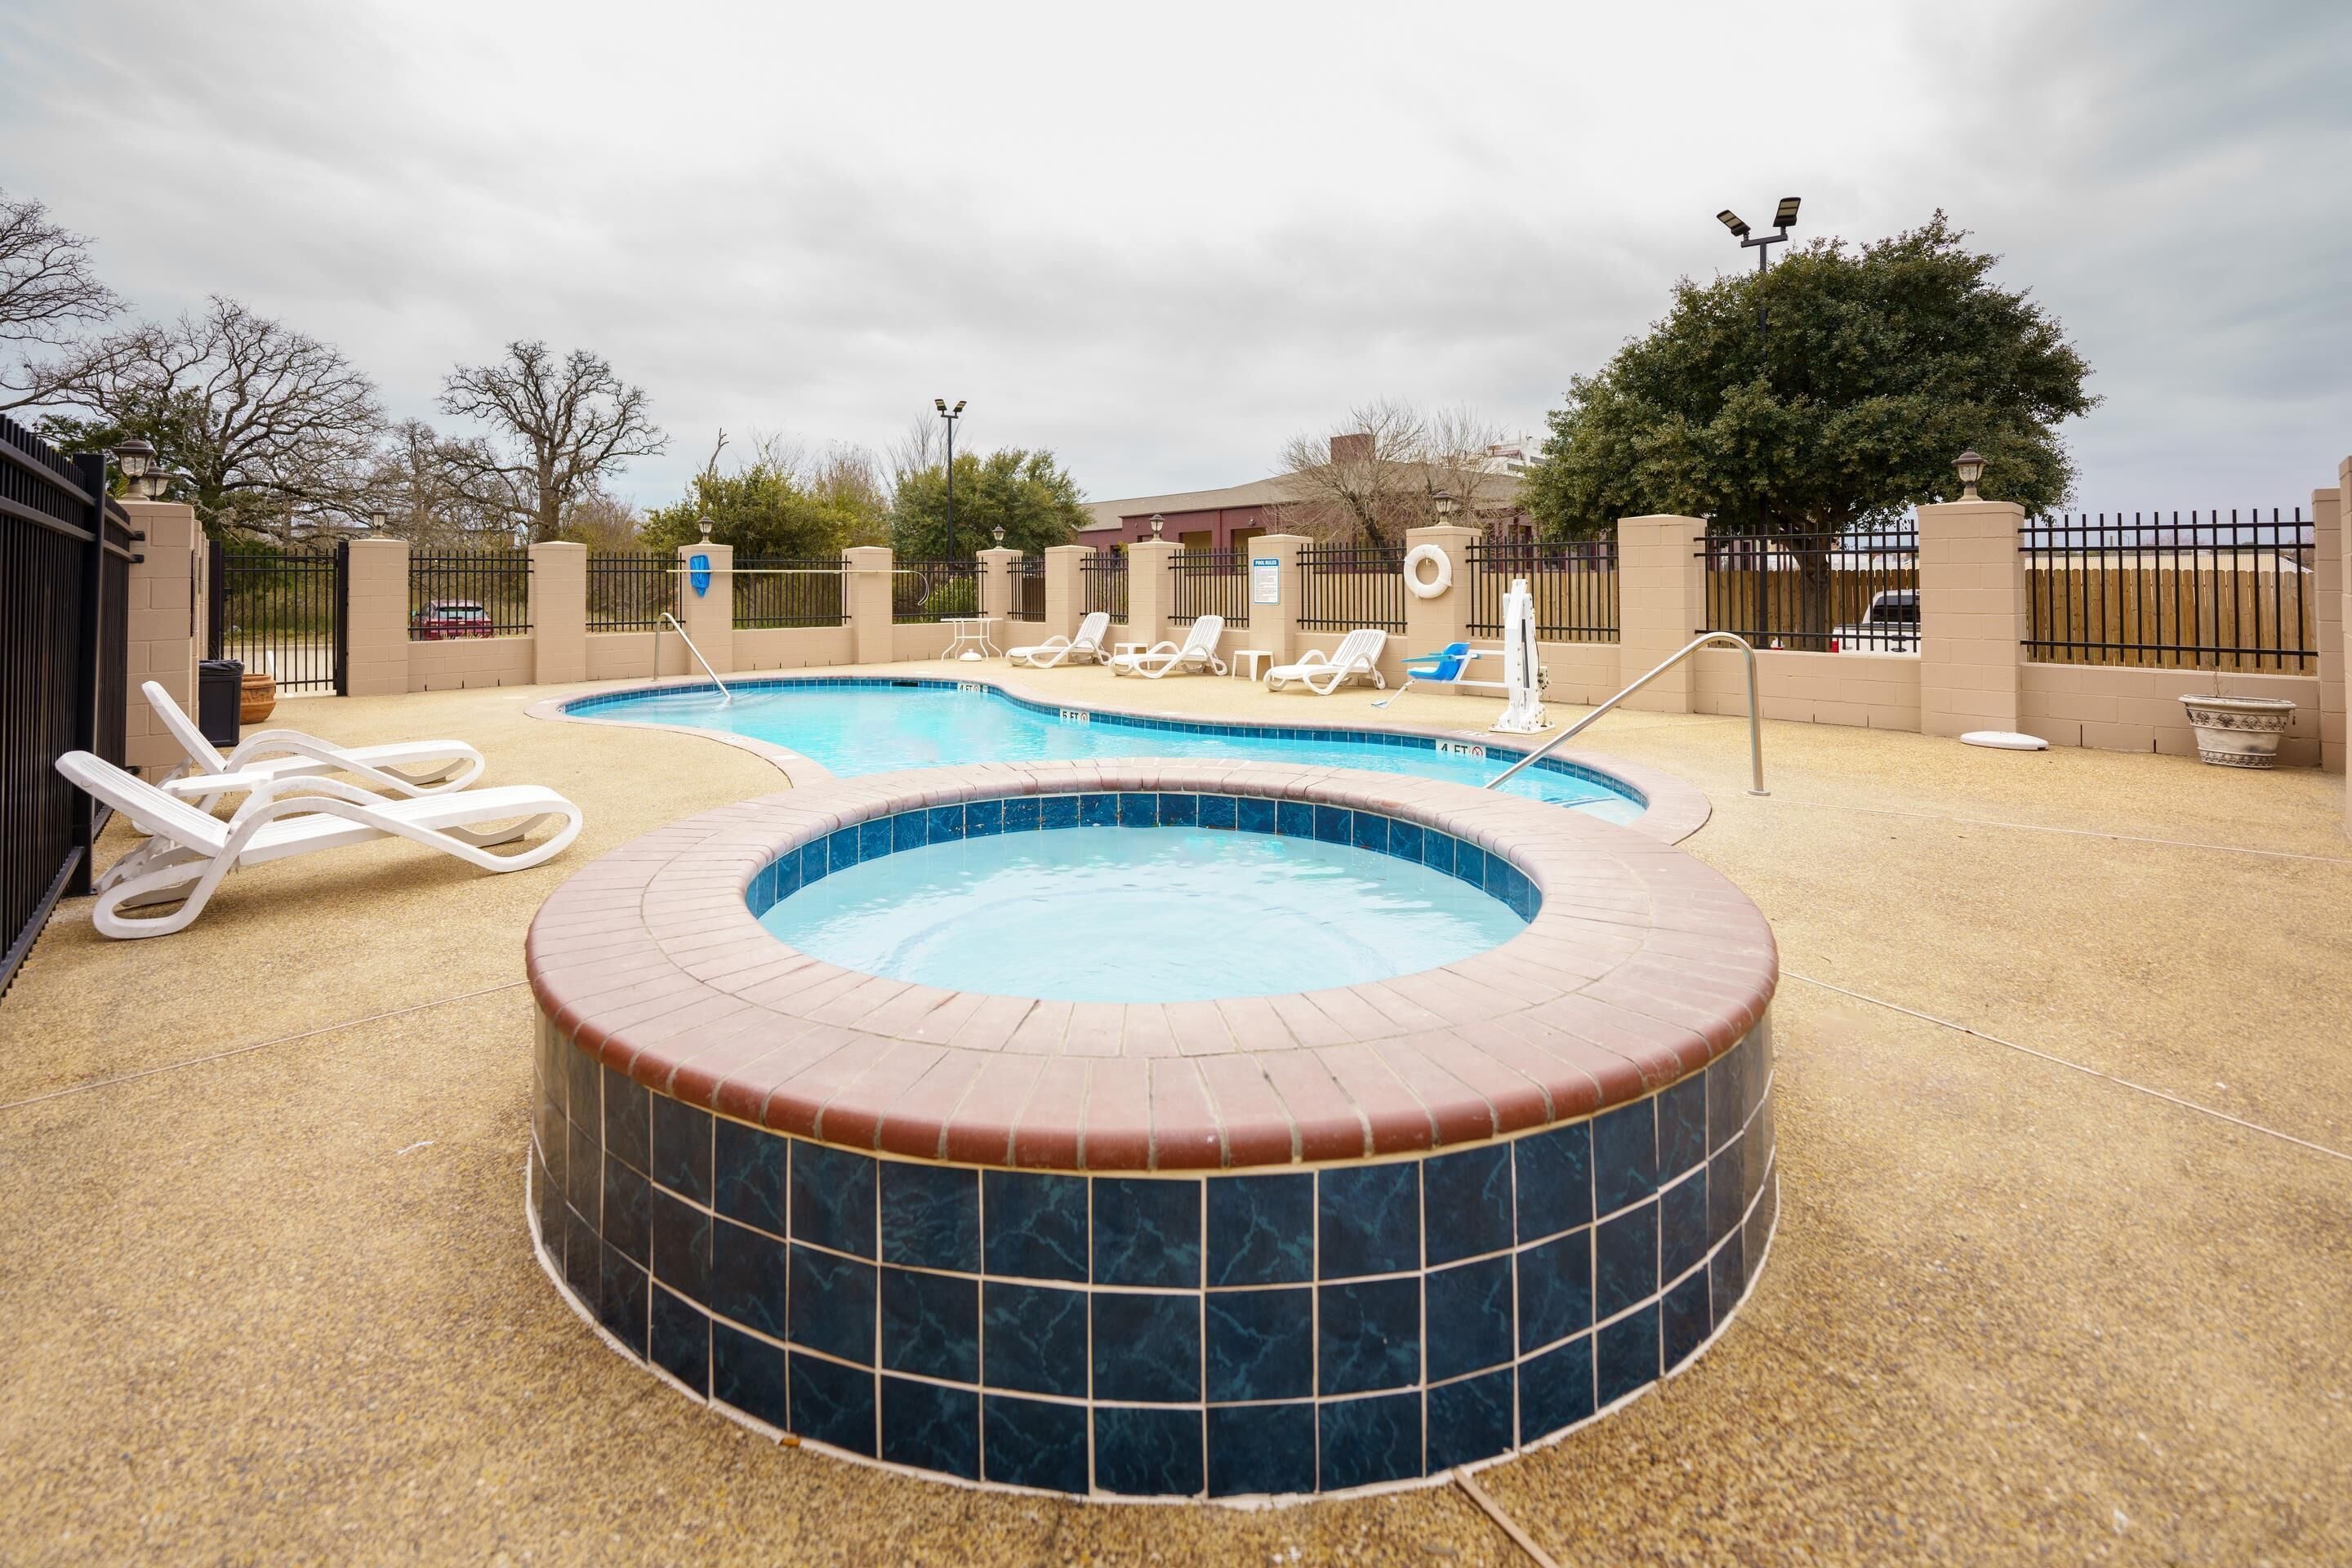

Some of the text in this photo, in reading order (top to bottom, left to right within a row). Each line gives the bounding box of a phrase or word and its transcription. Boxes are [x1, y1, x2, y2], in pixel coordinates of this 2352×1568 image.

[966, 684, 973, 693] FT
[1070, 711, 1079, 719] FT
[1454, 744, 1468, 754] FT
